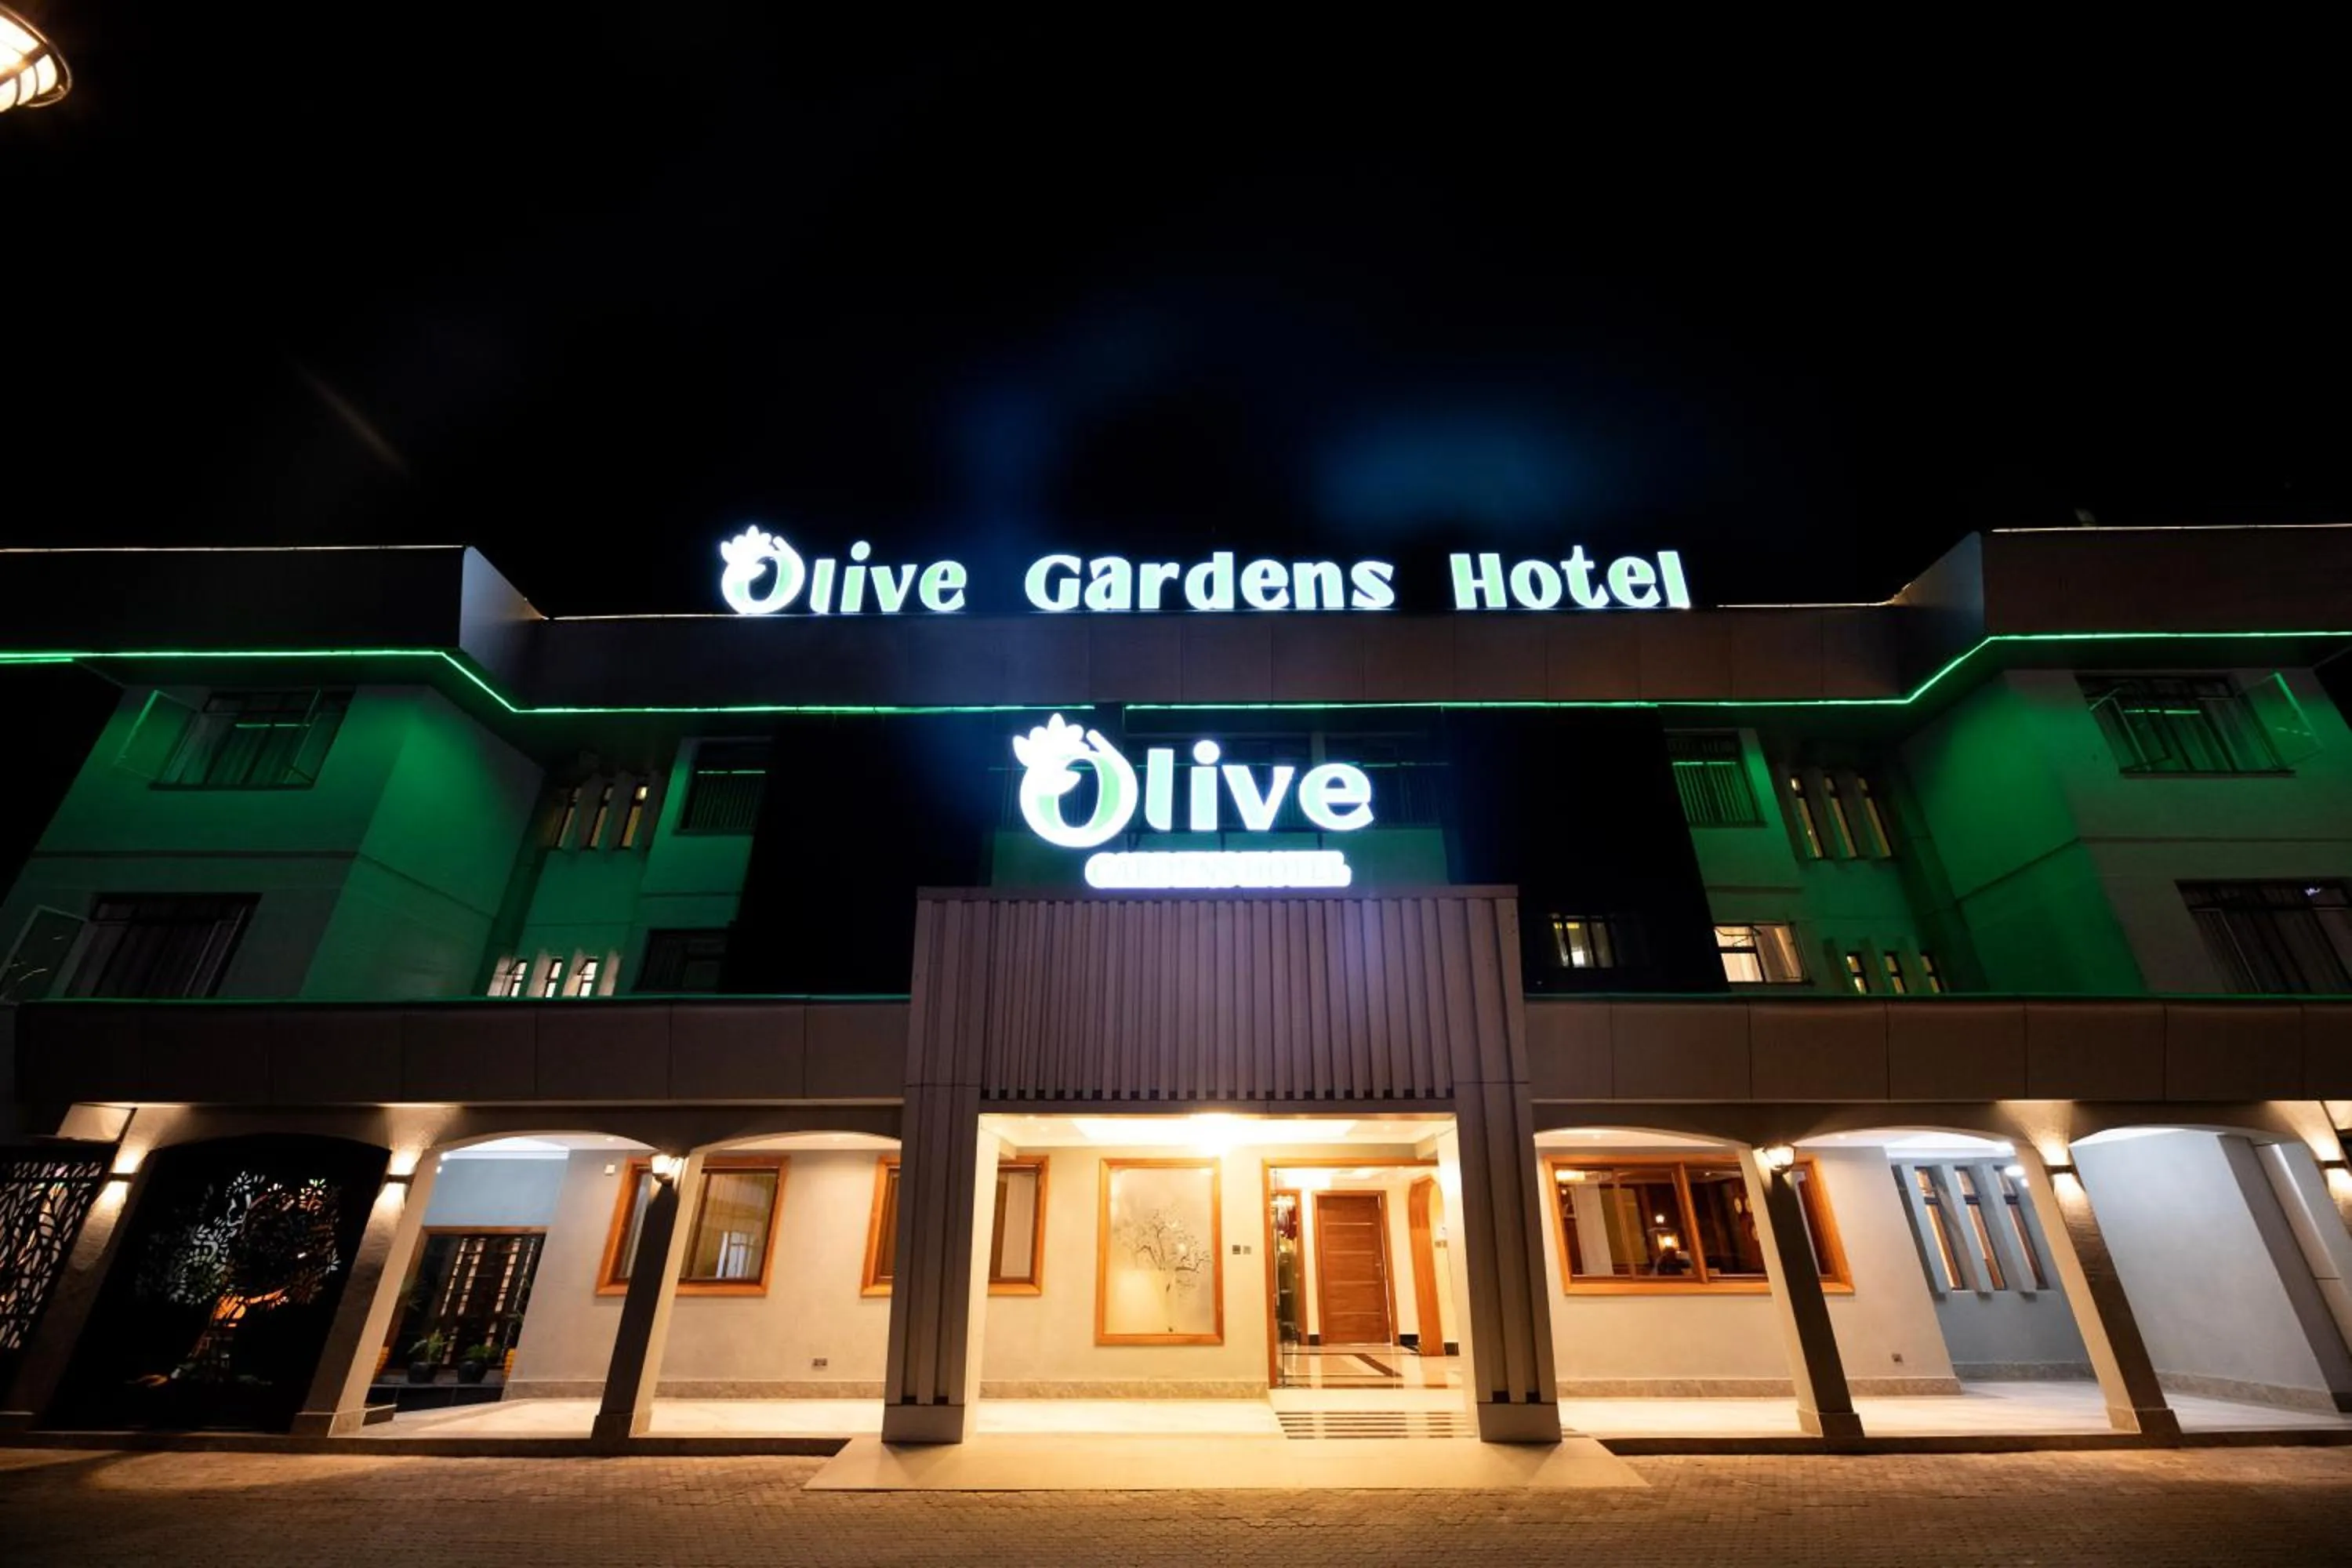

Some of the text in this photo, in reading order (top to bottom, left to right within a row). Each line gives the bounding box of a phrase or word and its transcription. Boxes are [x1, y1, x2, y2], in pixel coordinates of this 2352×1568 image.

[720, 524, 1690, 615] Olive Gardens Hotel
[1012, 712, 1374, 848] Olive
